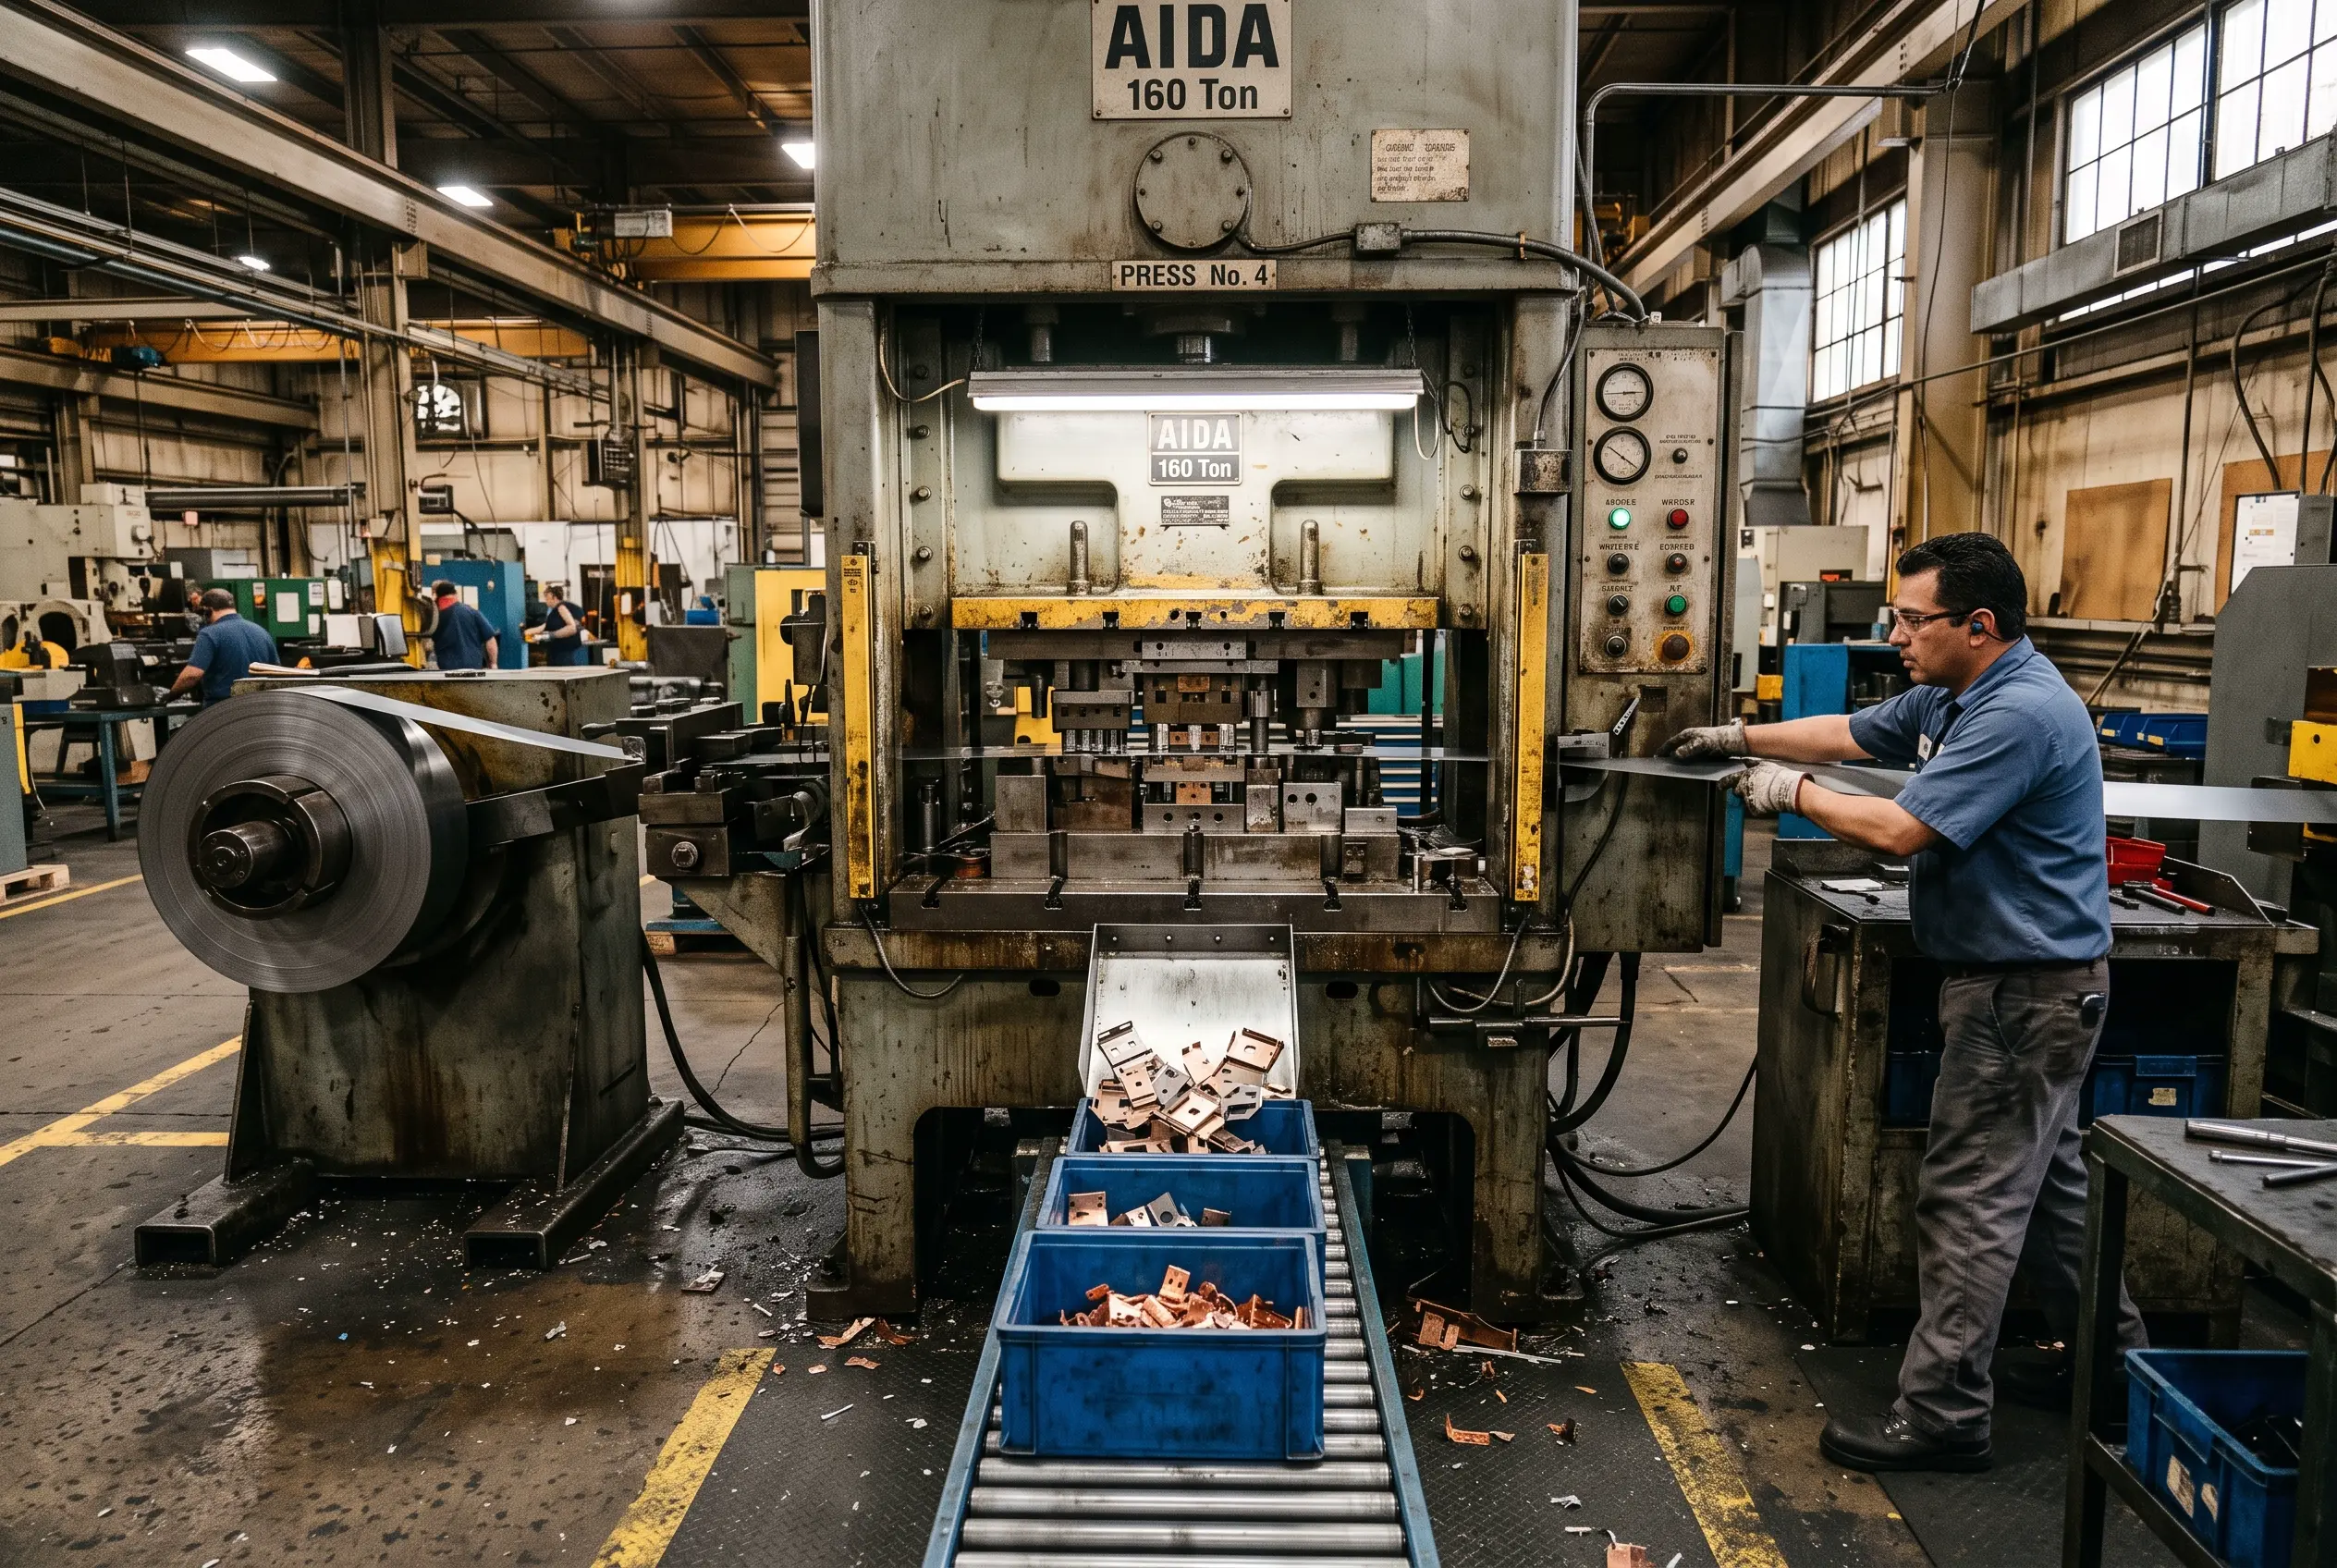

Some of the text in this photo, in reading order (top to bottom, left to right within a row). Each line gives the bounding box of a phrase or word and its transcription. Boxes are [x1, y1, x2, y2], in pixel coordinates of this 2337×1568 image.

[1105, 4, 1279, 69] AIDA
[1127, 79, 1258, 110] 160 Ton
[1120, 264, 1268, 286] PRESS No. 4
[1157, 419, 1233, 449] AIDA
[1158, 459, 1231, 478] 160 Ton
